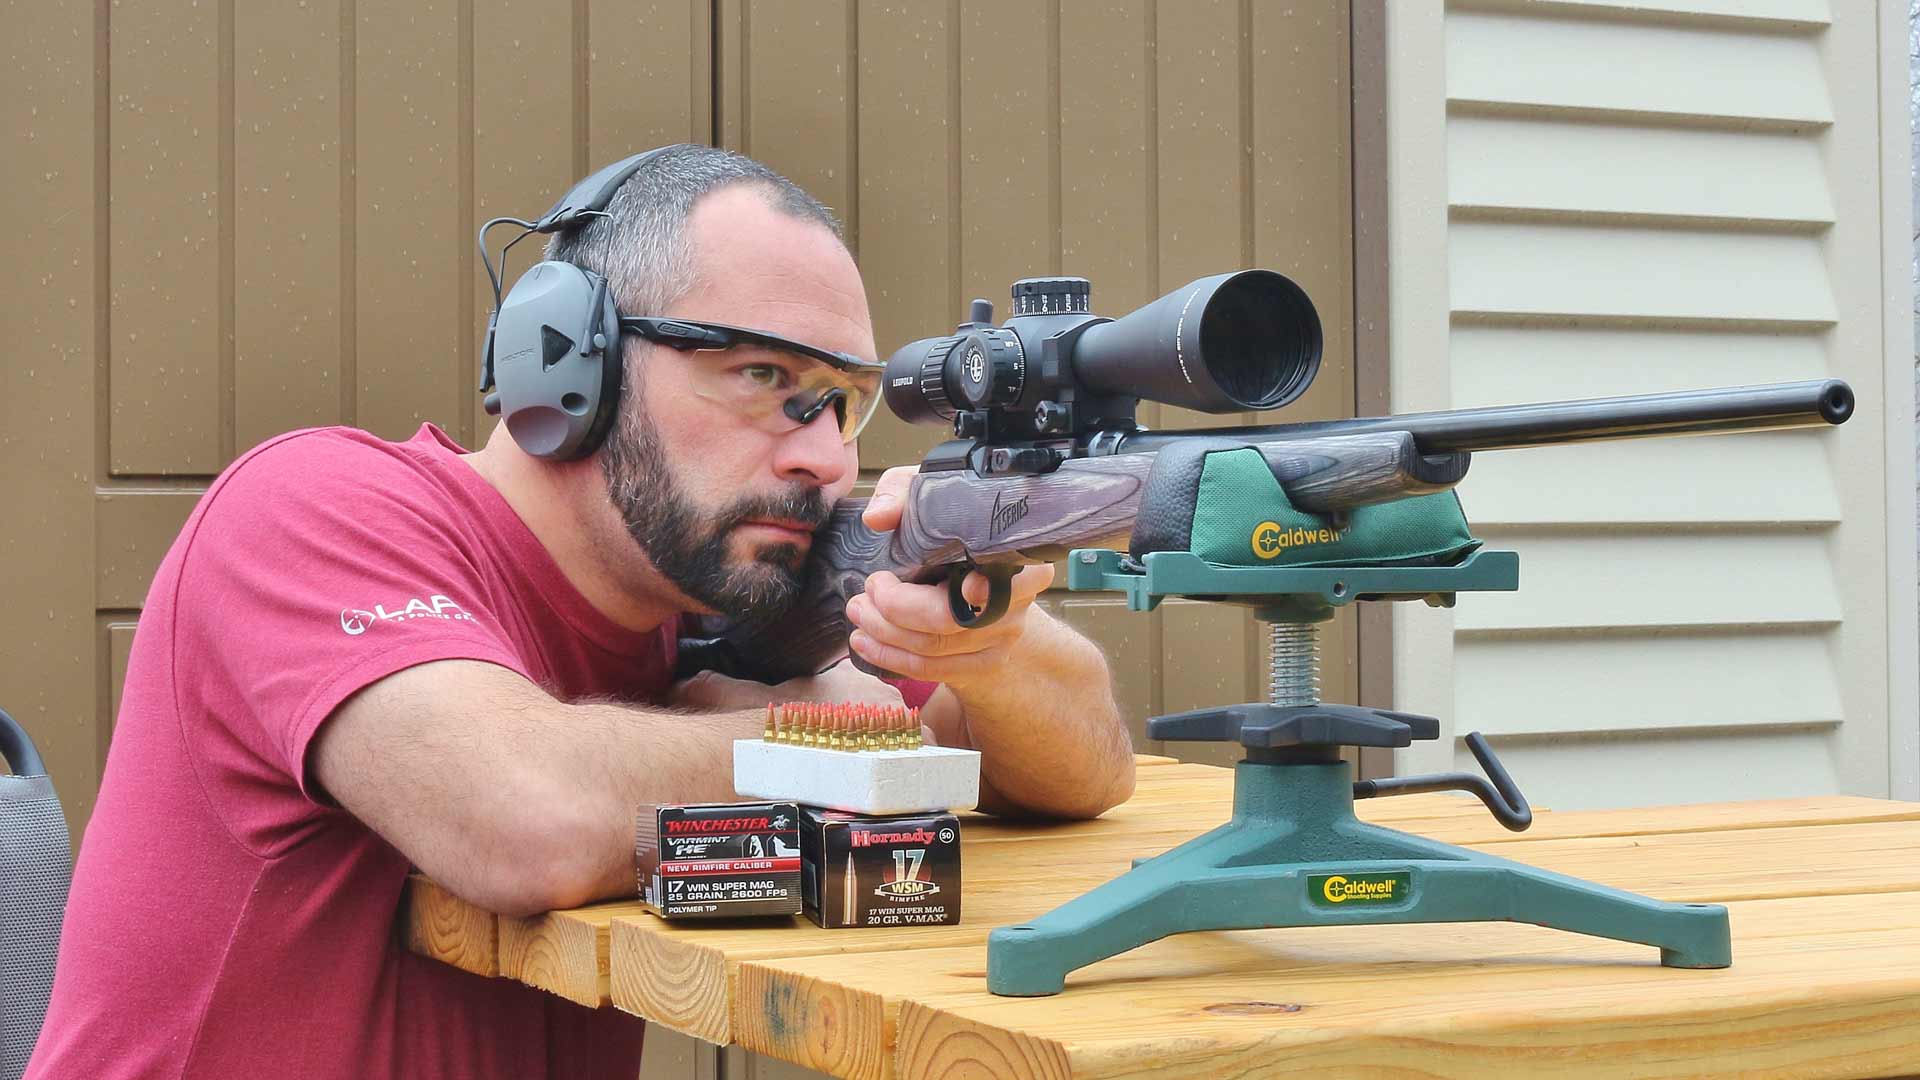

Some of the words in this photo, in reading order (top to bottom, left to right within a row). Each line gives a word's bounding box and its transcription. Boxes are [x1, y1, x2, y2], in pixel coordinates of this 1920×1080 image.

[1001, 495, 1029, 531] SERIES
[374, 595, 471, 620] LAP
[665, 817, 770, 833] WINCHESTER
[667, 836, 731, 847] VARMINT
[851, 827, 936, 848] Hornady
[675, 844, 708, 856] HE
[667, 865, 689, 873] NEW
[692, 864, 731, 872] RIMFIRE
[733, 861, 773, 870] CALIBER
[892, 848, 926, 882] 17
[667, 880, 685, 893] 17
[687, 883, 710, 892] WIN
[712, 882, 747, 891] SUPER
[749, 880, 775, 889] MAG
[891, 882, 924, 894] WSM
[668, 893, 683, 901] 25
[731, 889, 763, 899] 2600
[766, 888, 788, 897] FPS
[889, 894, 926, 903] RIMFIRE
[668, 905, 704, 914] POLYMER
[705, 904, 718, 912] TIP
[868, 908, 878, 916] 17
[877, 907, 896, 915] WIN
[867, 915, 881, 925] 20
[882, 915, 903, 924] GR.
